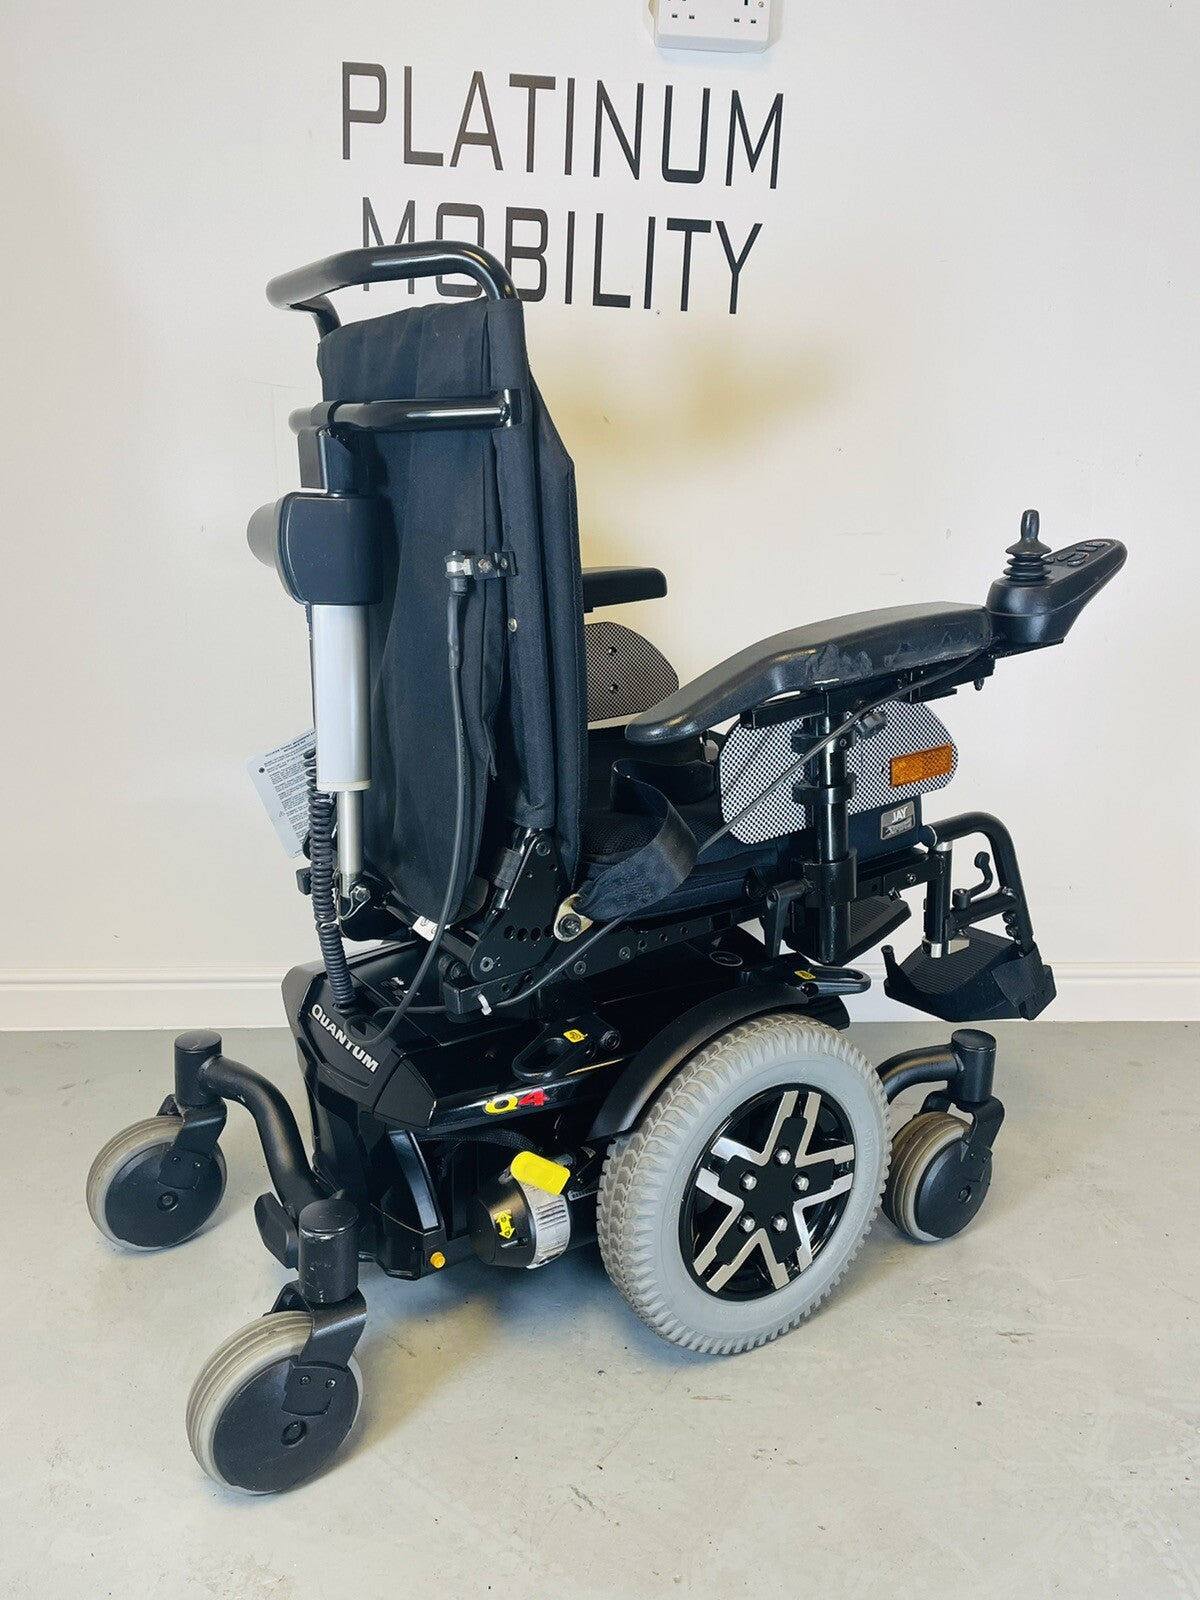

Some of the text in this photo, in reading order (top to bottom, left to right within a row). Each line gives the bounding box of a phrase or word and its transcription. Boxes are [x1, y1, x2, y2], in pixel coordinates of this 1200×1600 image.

[342, 61, 784, 190] PLATINUM
[362, 197, 763, 315] MOBILITY
[891, 806, 909, 824] JAY
[311, 1004, 379, 1074] QUANTUM
